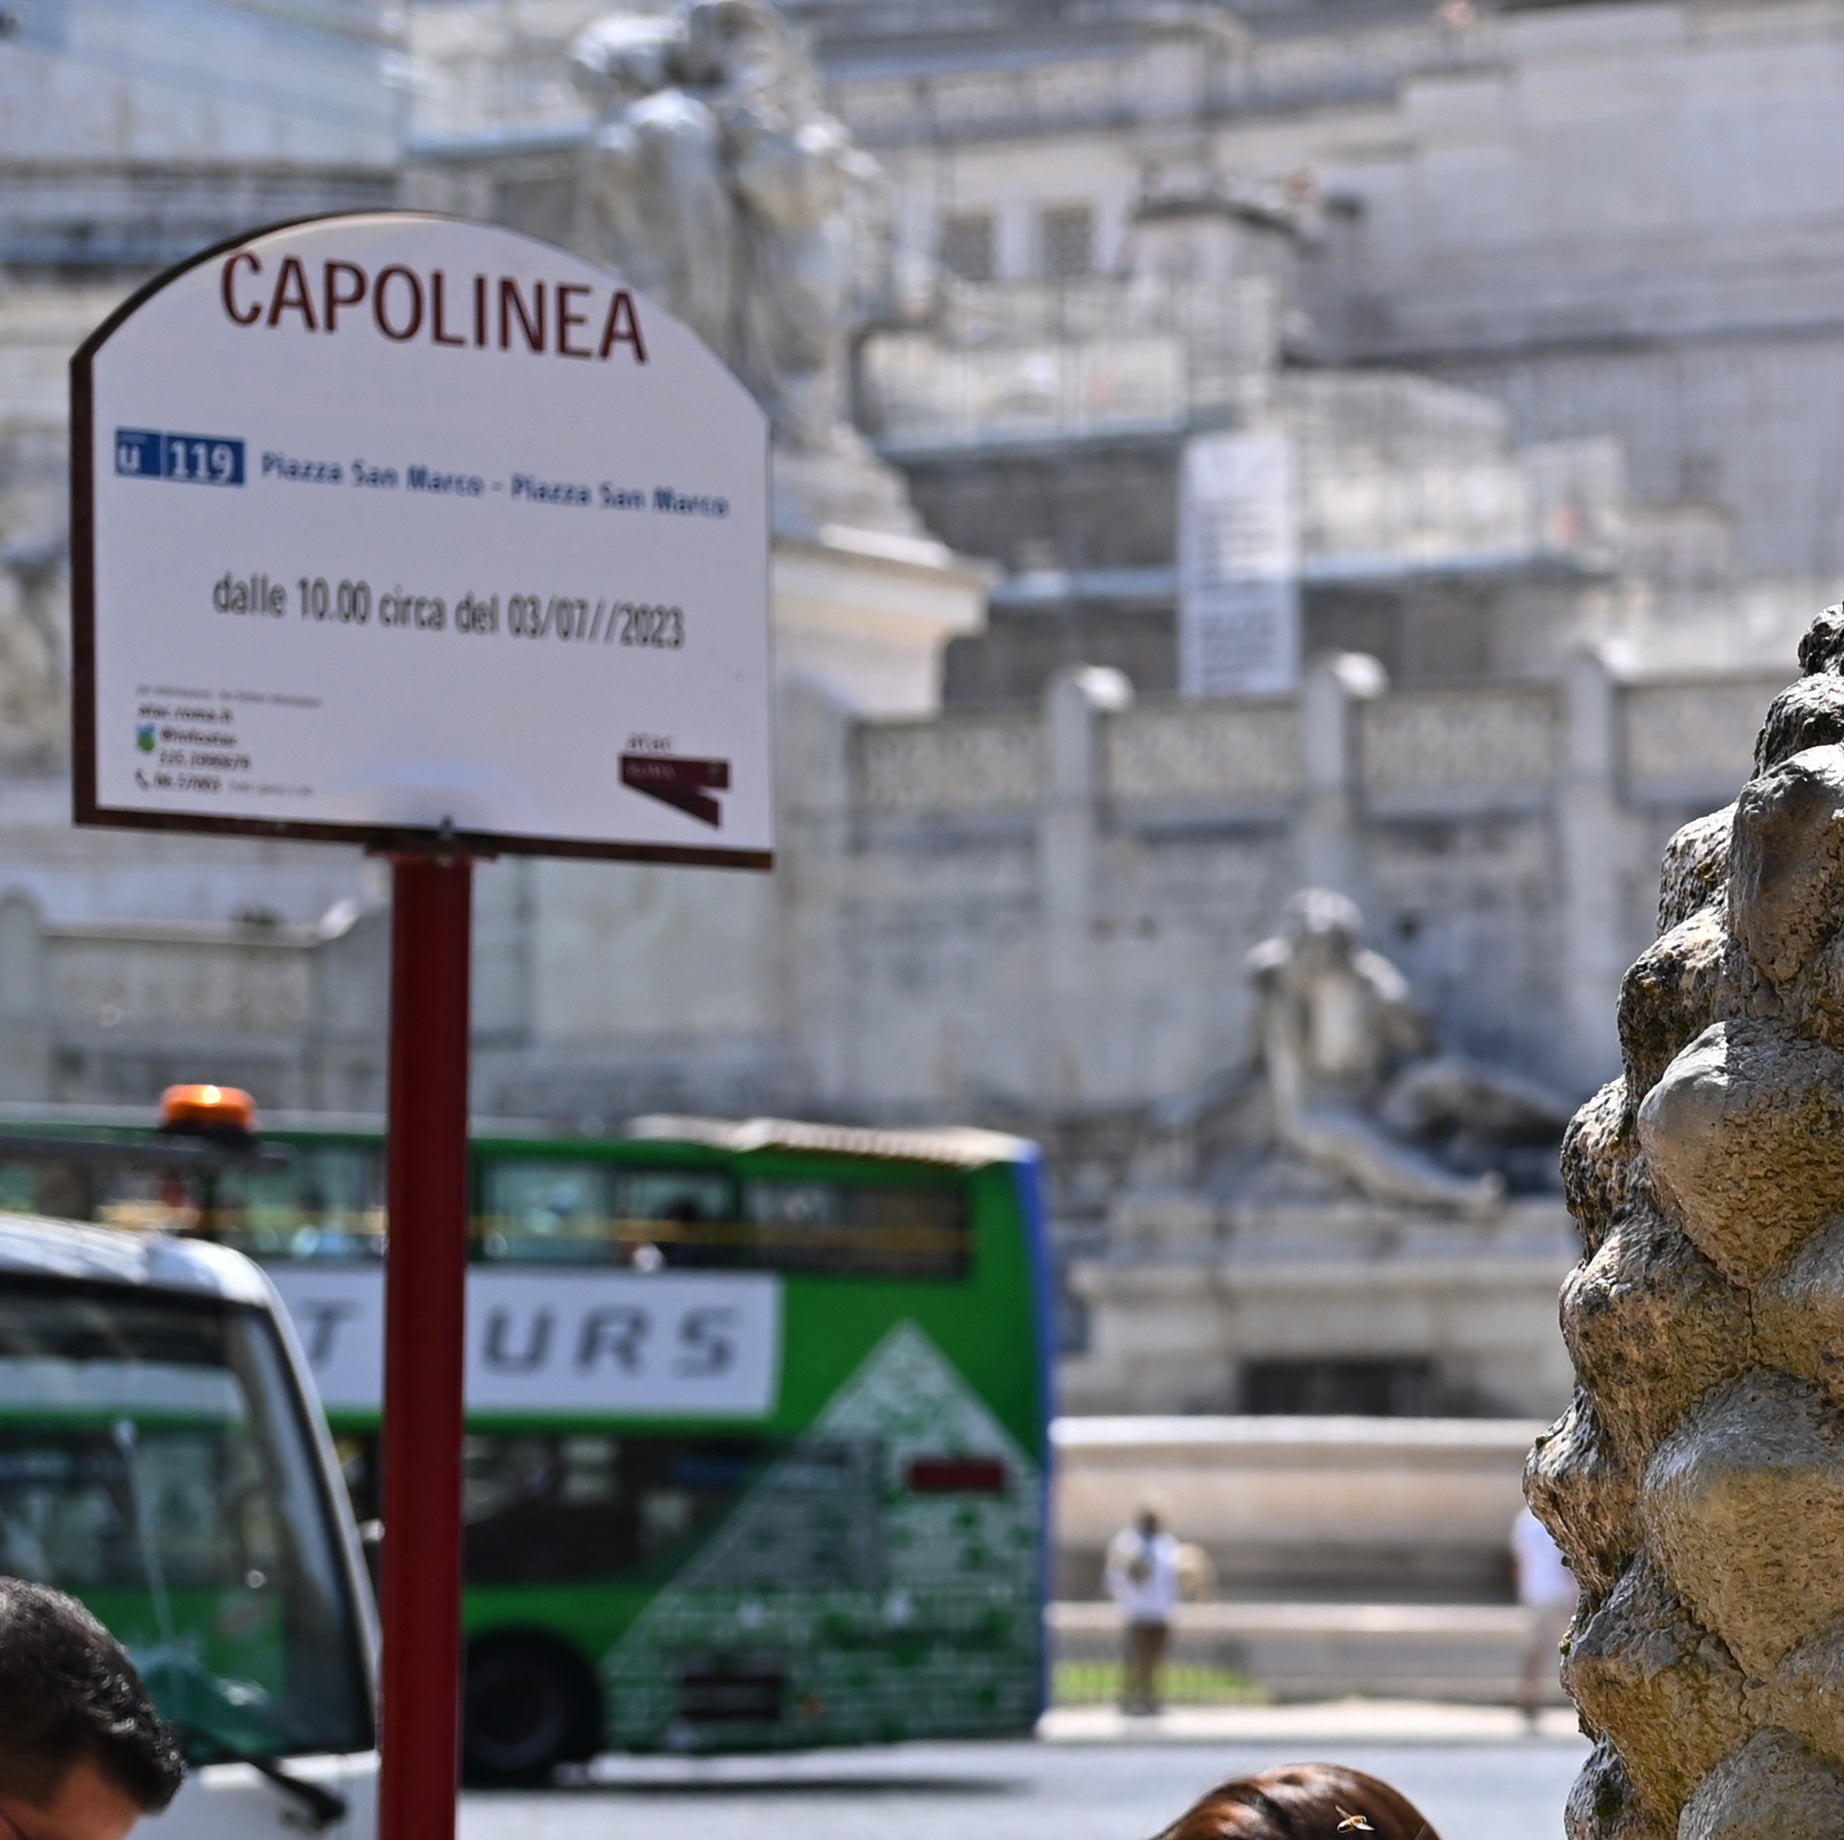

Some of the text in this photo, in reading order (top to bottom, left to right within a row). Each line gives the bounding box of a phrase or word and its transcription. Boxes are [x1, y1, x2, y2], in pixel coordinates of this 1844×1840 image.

[221, 249, 649, 365] CAPOLINEA
[169, 439, 235, 483] 119
[261, 450, 344, 486] Piazza
[350, 458, 399, 489] San
[406, 463, 486, 498] Marco
[511, 472, 592, 507] Piazza
[598, 479, 646, 511] San
[652, 485, 730, 520] Marco
[212, 569, 686, 651] dalle 10.00 circa del 03/07//2023
[299, 1304, 742, 1379] TURS
